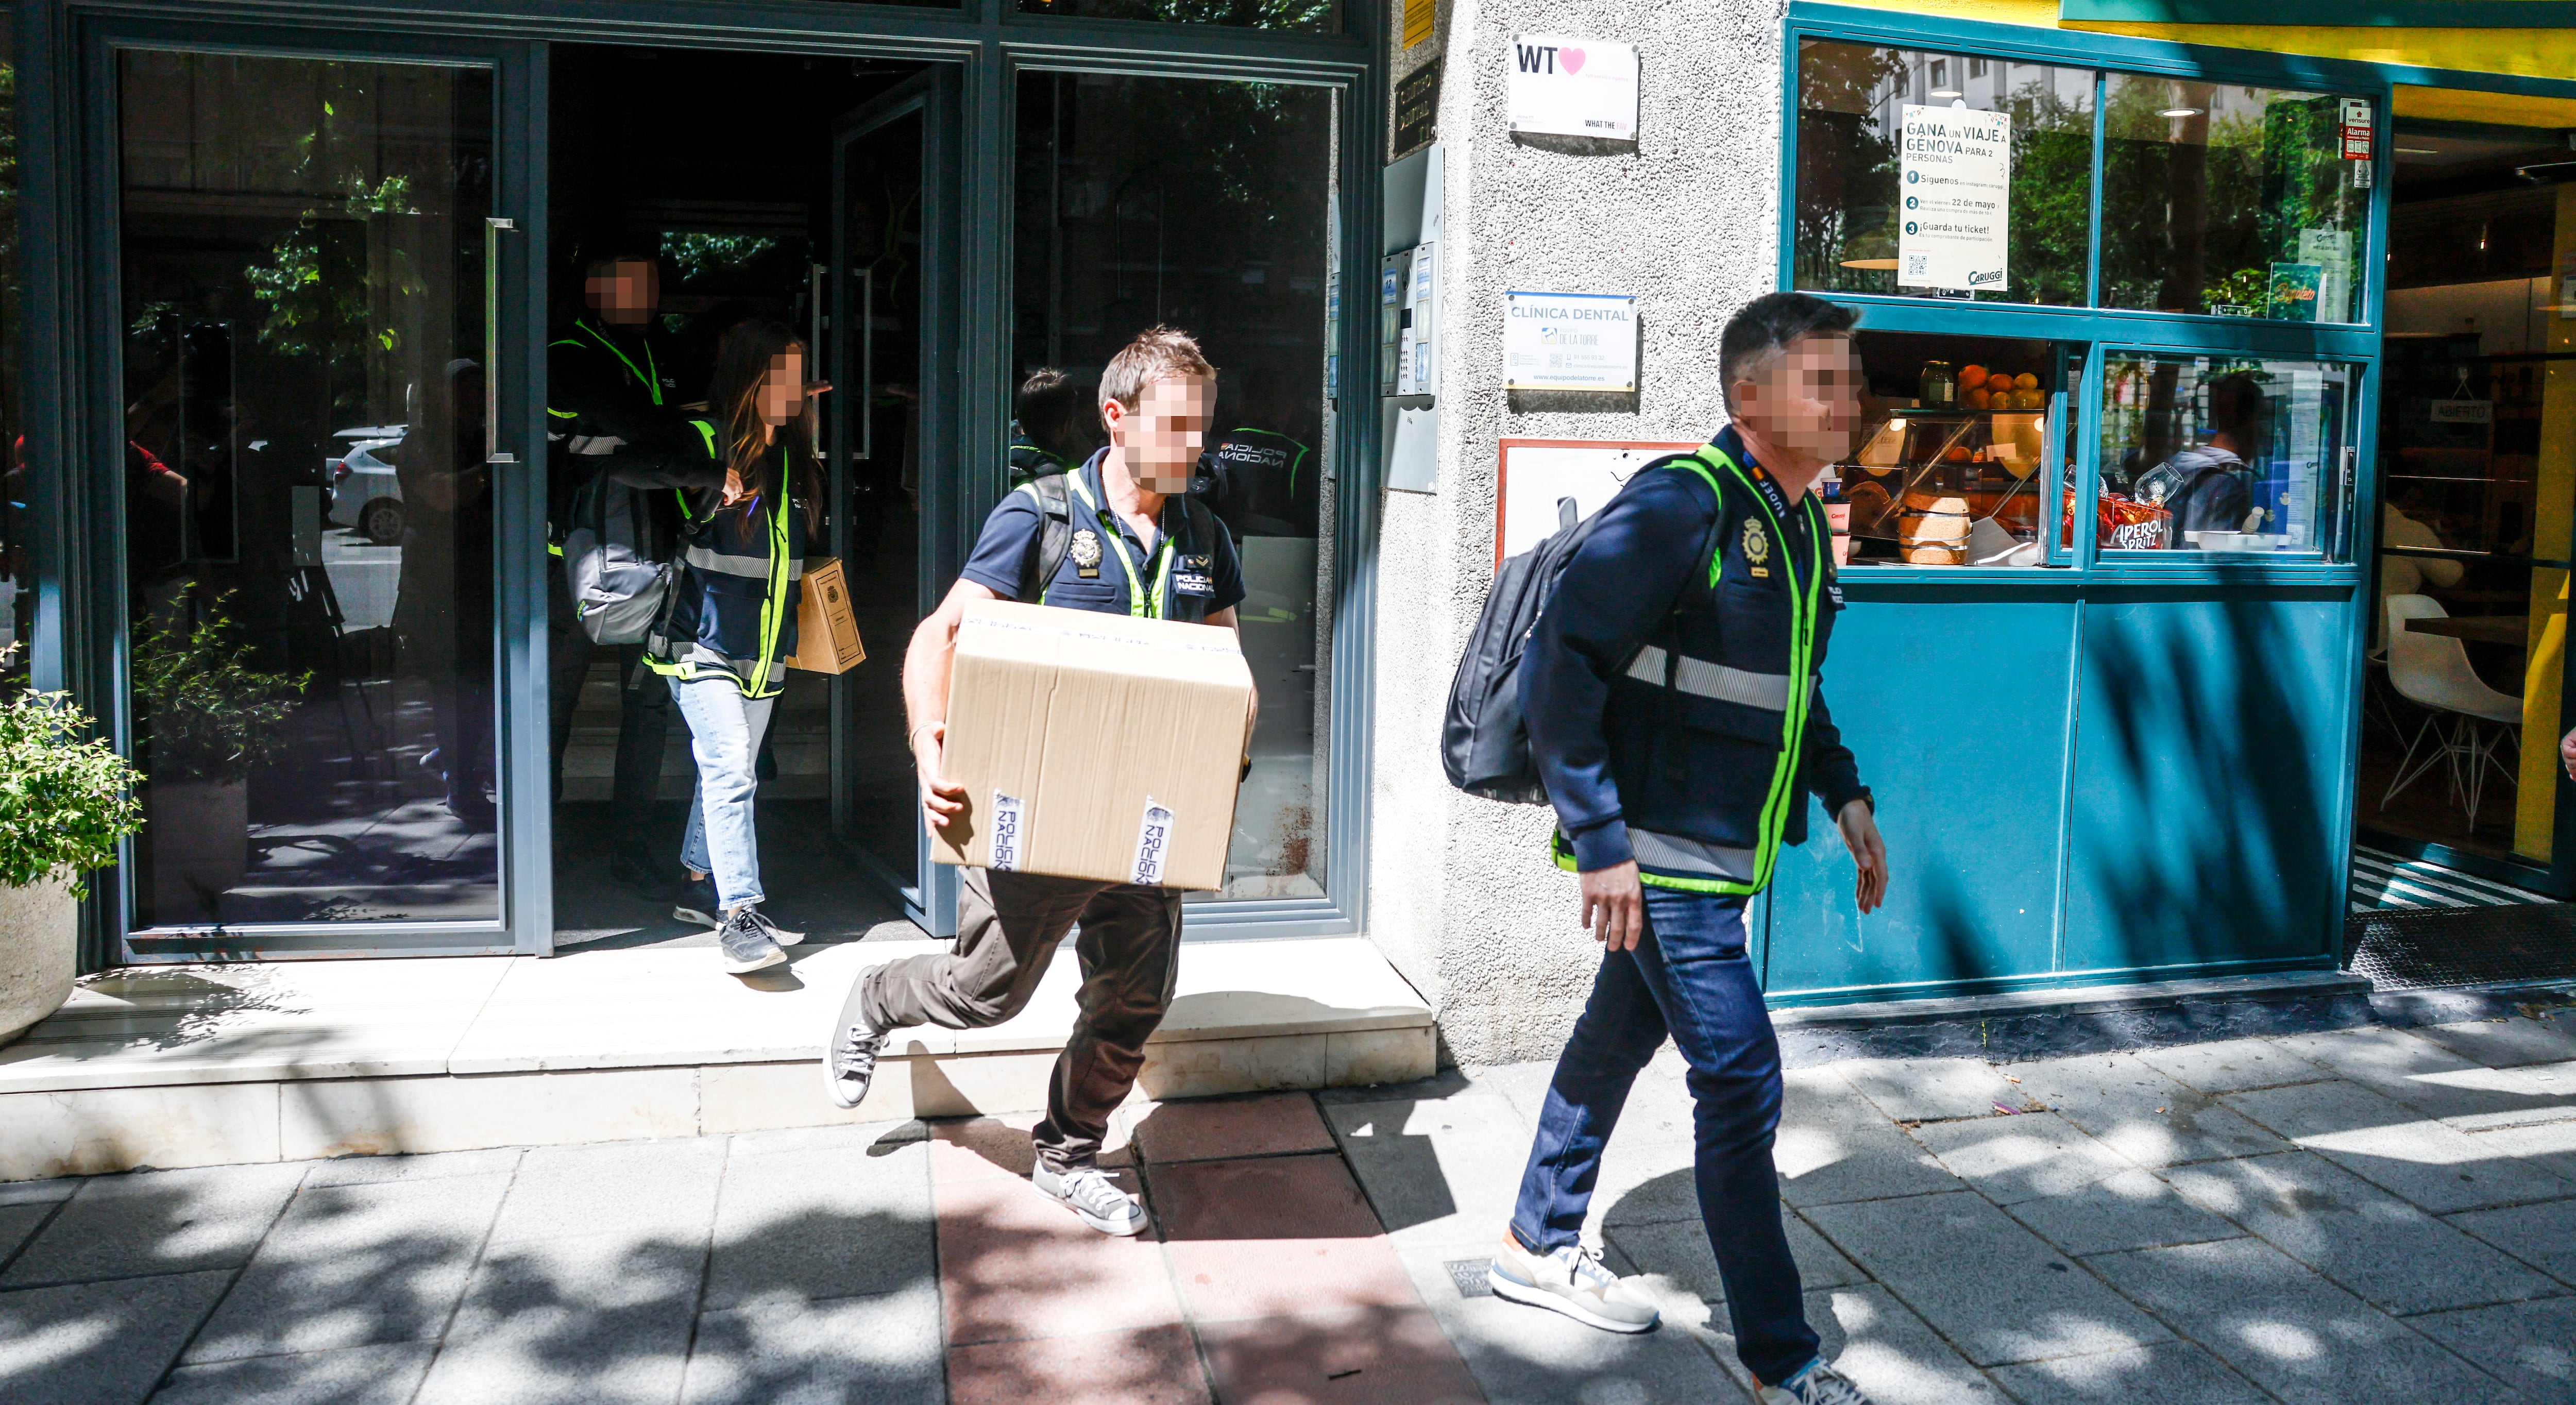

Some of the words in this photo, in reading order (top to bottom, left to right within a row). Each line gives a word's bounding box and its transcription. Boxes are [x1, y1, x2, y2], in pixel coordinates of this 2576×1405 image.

[1517, 44, 1558, 75] WT
[1585, 119, 1603, 128] WHAT
[1604, 121, 1615, 129] THE
[1616, 122, 1627, 130] FAV
[2347, 127, 2370, 136] Alarma
[1907, 122, 1946, 138] GANA
[1949, 129, 1961, 138] UN
[1963, 126, 1999, 142] VIAJE
[2001, 135, 2006, 143] A
[1907, 134, 1963, 155] GÉNOVA
[1965, 147, 1987, 157] PARA
[1906, 153, 1953, 164] PERSONAS
[1921, 174, 1959, 185] Síguenos
[1965, 181, 1988, 189] instagram:
[1963, 198, 1973, 207] de
[1975, 201, 1995, 210] mayo
[1908, 224, 1915, 234] 3
[1920, 222, 1953, 232] ¡Guarda
[1965, 224, 1989, 234] ticket!
[1385, 279, 1392, 290] 12
[1511, 304, 1569, 319] CLÍNICA
[1573, 309, 1629, 321] DENTAL
[1560, 333, 1568, 345] DE
[1569, 334, 1578, 345] LA
[1579, 334, 1599, 346] TORRE
[2439, 404, 2486, 418] ABIERTO
[1759, 480, 1783, 511] UDEF
[2110, 519, 2163, 544] APEROL
[1175, 574, 1210, 584] POLICIA
[1177, 582, 1215, 592] NACIONAL
[1004, 811, 1016, 871] POLICIA
[1145, 826, 1164, 885] POLICIA
